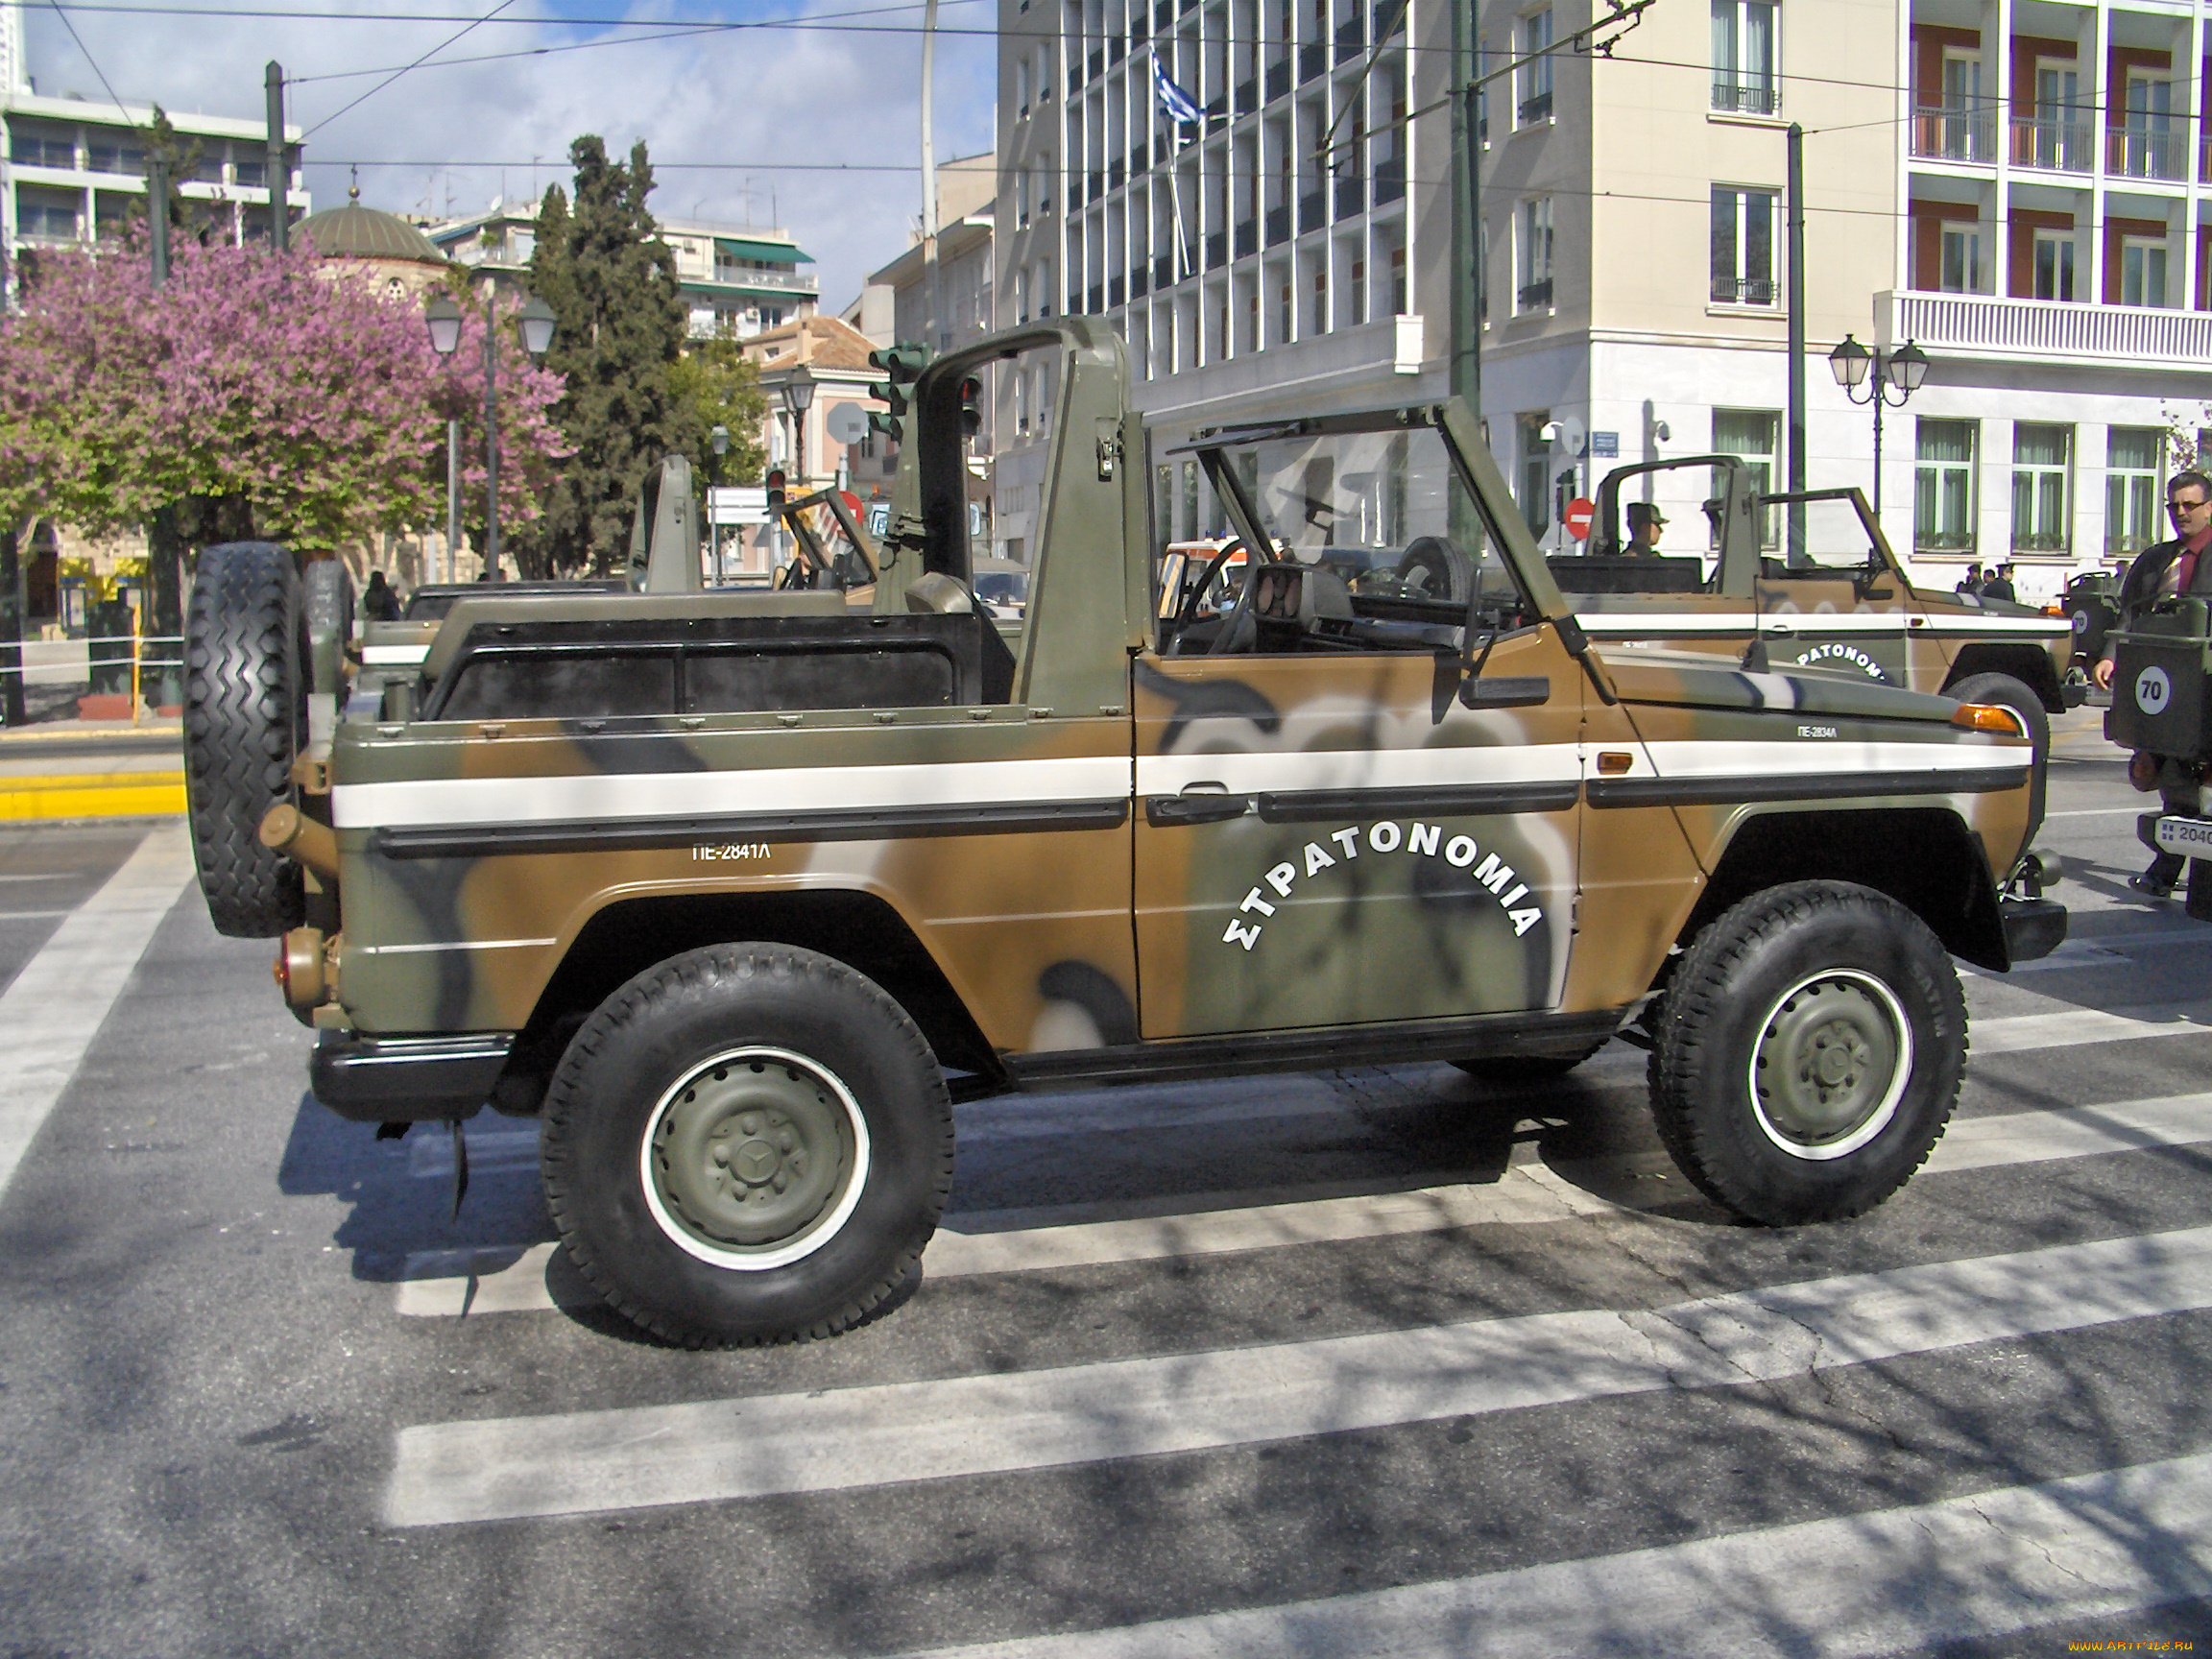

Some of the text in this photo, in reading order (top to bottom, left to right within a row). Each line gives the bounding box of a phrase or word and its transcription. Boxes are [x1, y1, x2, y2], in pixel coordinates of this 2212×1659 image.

[2141, 680, 2162, 701] 70
[691, 842, 771, 860] ΠΕ-2841Λ
[1221, 820, 1542, 951] ΣΤΡΑΤΟΝΟΜΙΑ
